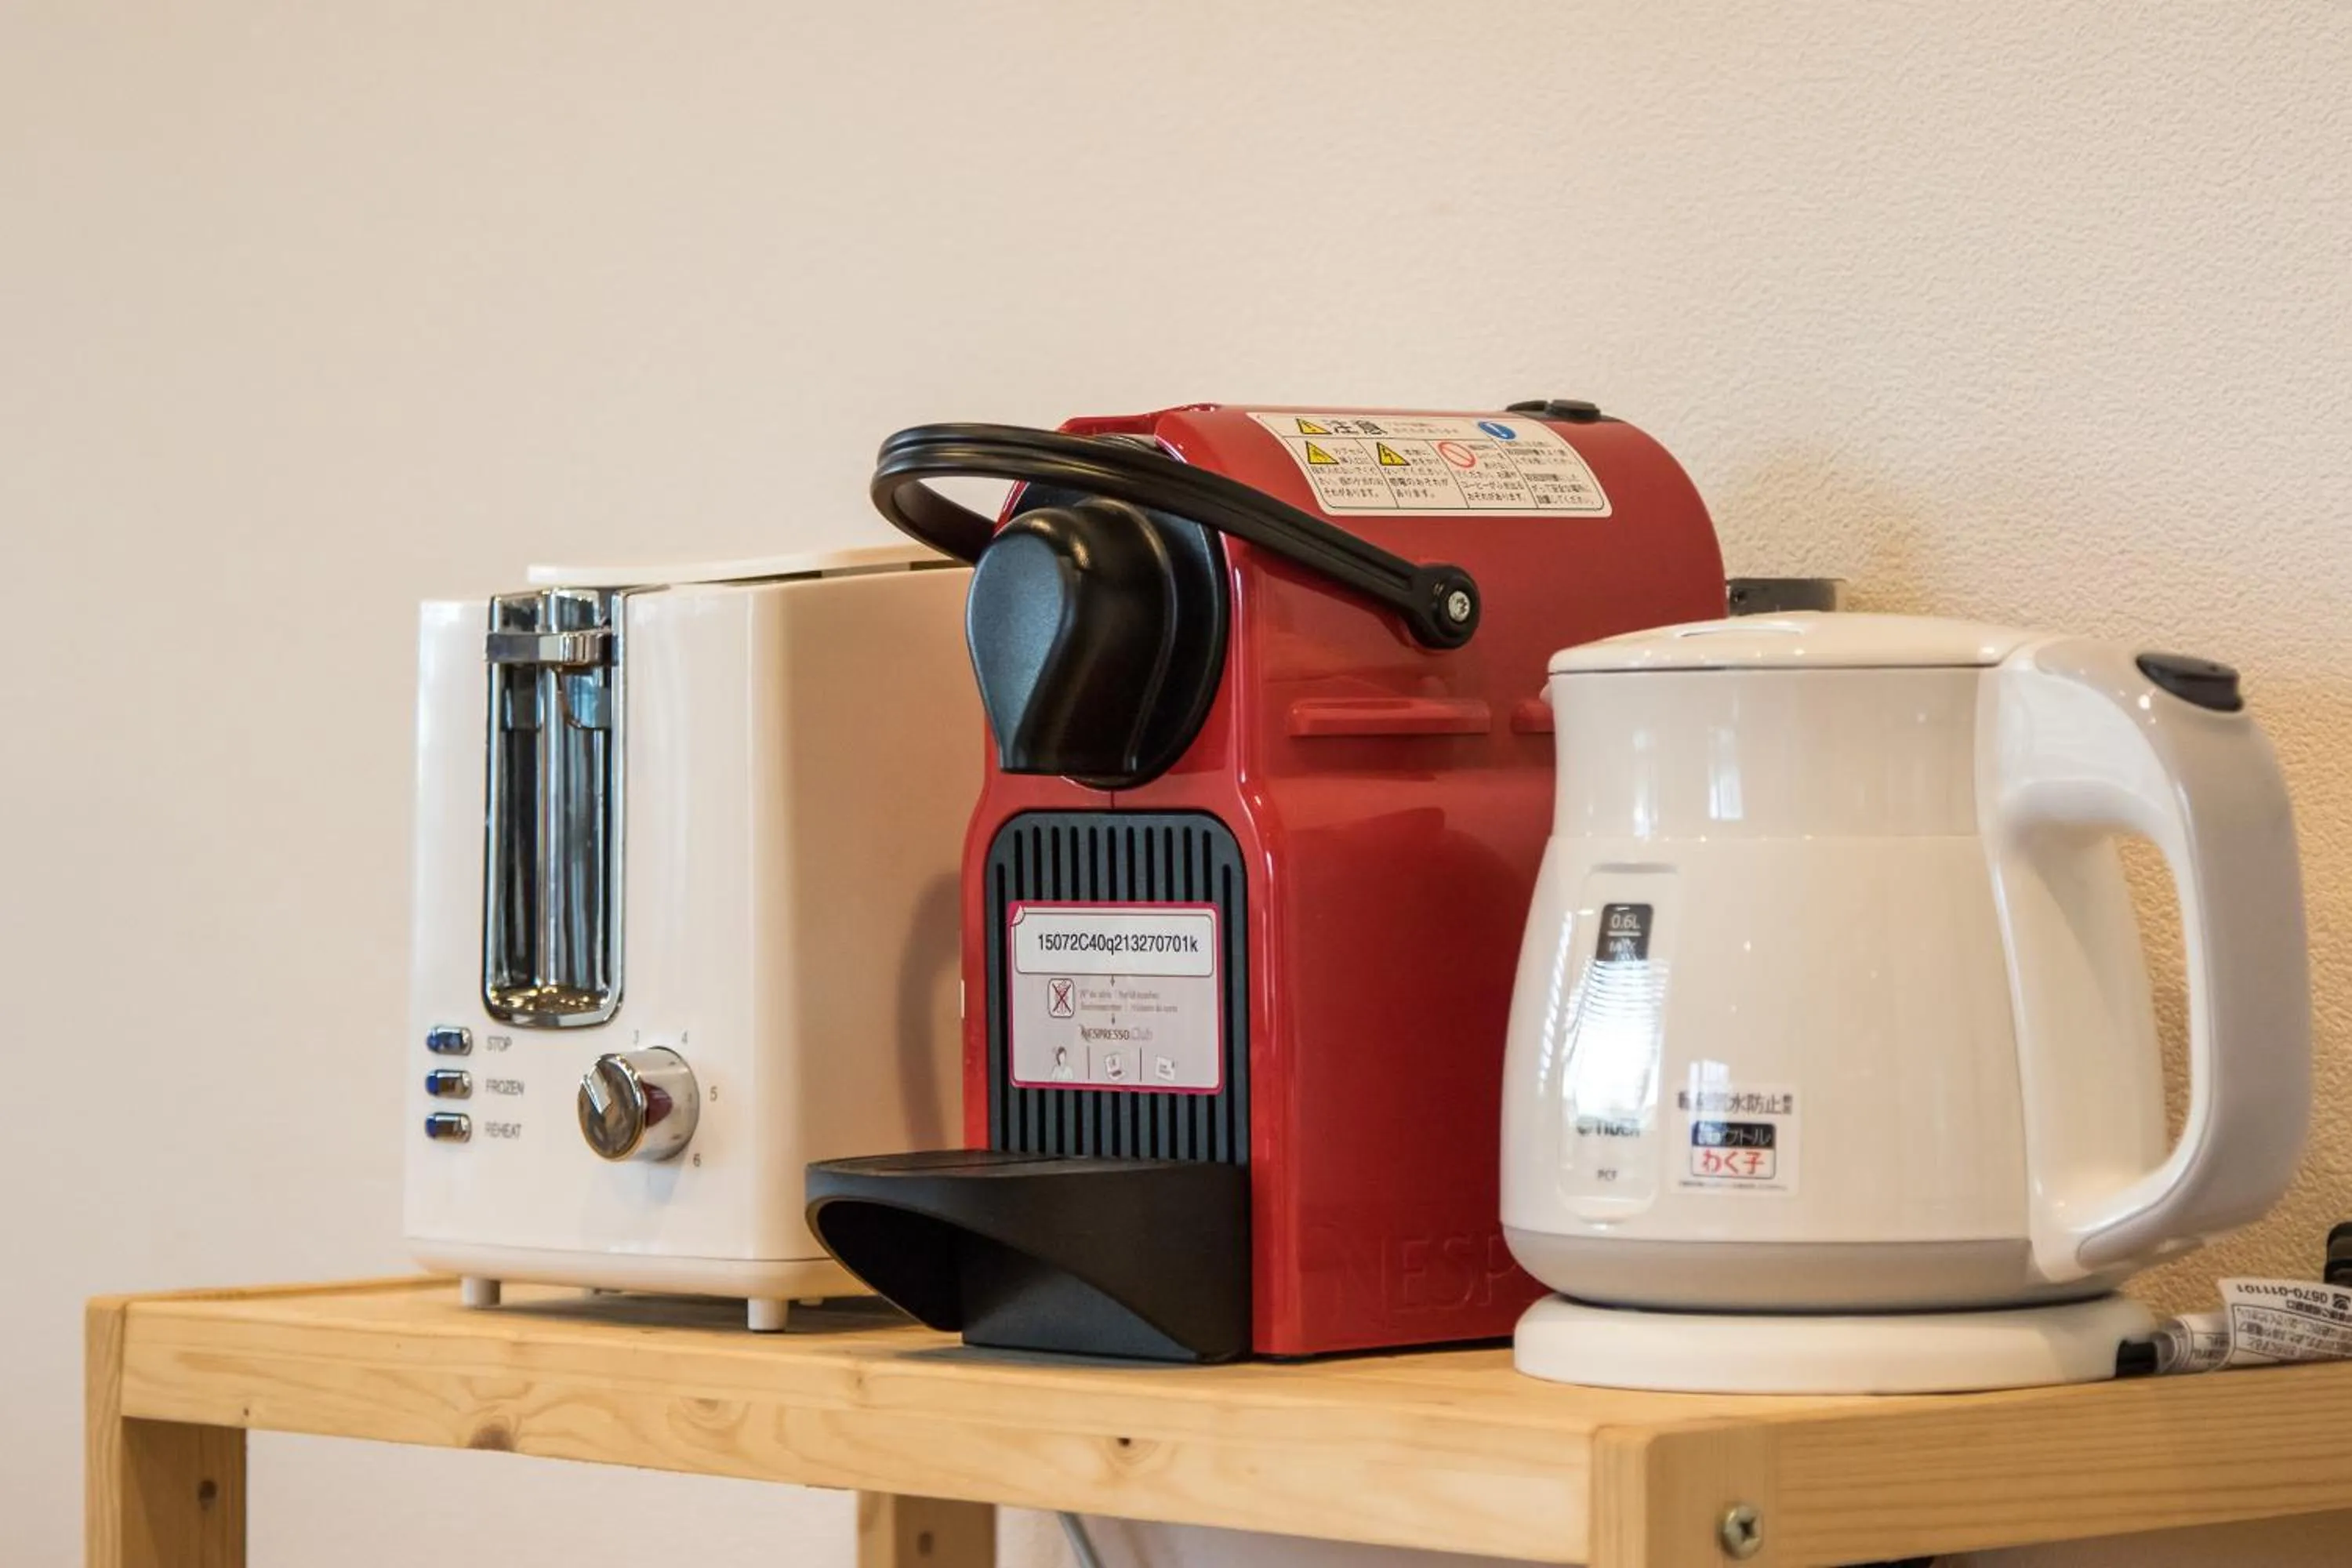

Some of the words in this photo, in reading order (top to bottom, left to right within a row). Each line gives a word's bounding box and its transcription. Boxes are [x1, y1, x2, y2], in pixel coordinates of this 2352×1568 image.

[1611, 913, 1641, 929] 0.6L
[1038, 933, 1198, 956] 15072C40q213270701k
[486, 1037, 512, 1051] STOP
[485, 1080, 524, 1096] FROZEN
[710, 1087, 717, 1102] 5
[485, 1124, 521, 1139] REHEAT
[693, 1154, 701, 1167] 6
[1702, 1149, 1766, 1175] わく子
